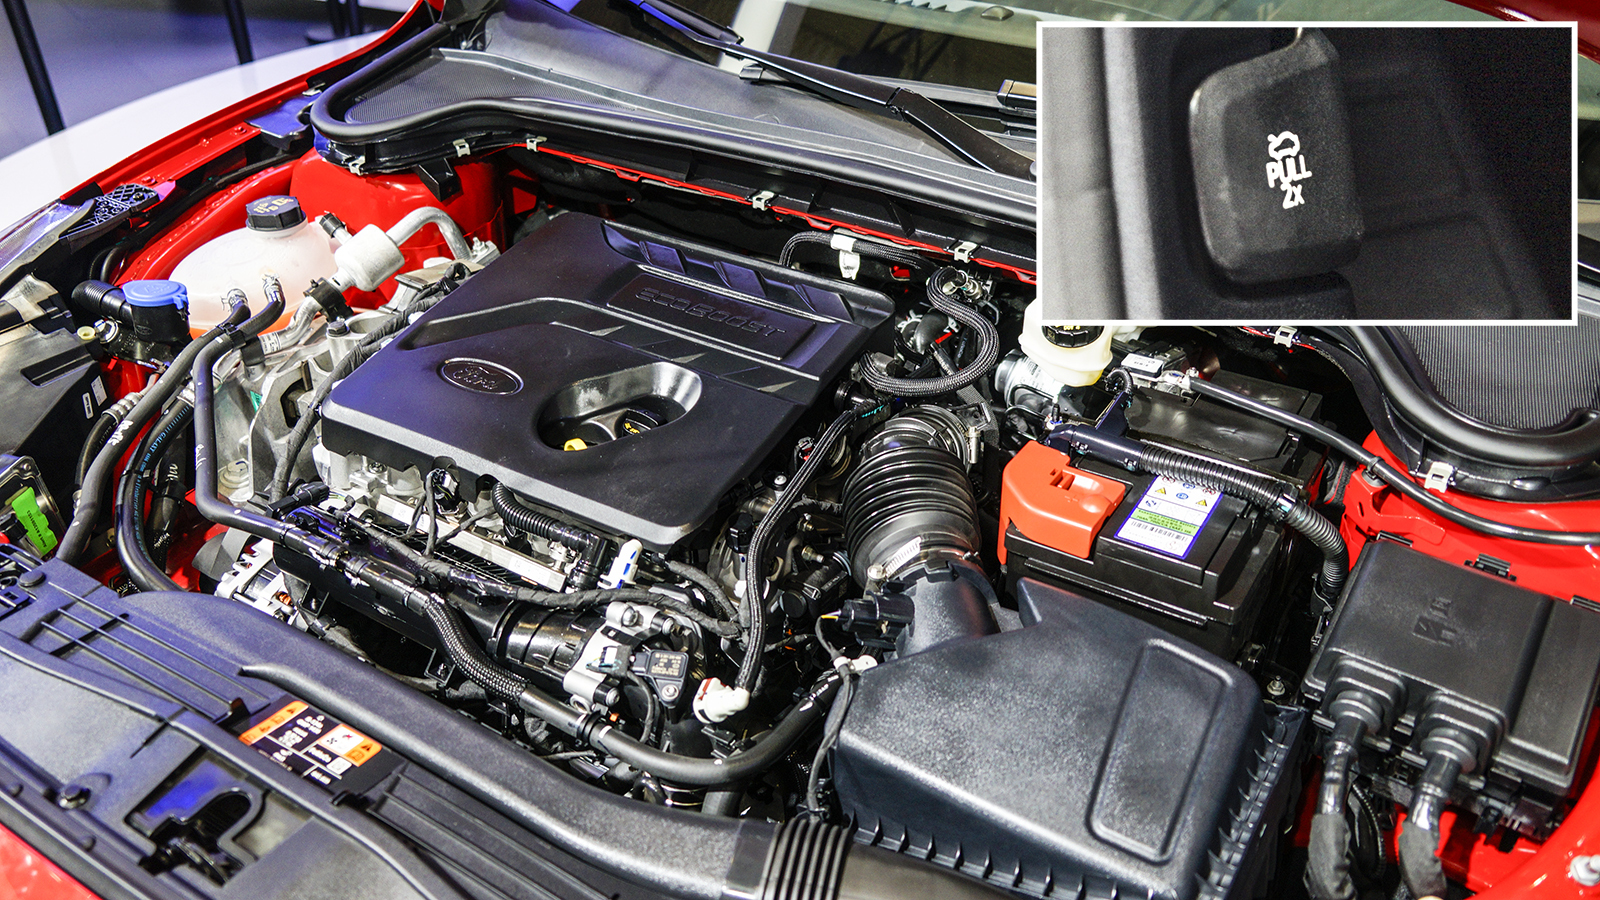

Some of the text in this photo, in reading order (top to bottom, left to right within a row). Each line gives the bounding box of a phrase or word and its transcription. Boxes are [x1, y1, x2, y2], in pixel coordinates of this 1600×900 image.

[1266, 154, 1313, 188] PULL
[635, 287, 786, 336] ECOBOOST
[453, 366, 498, 390] Ford
